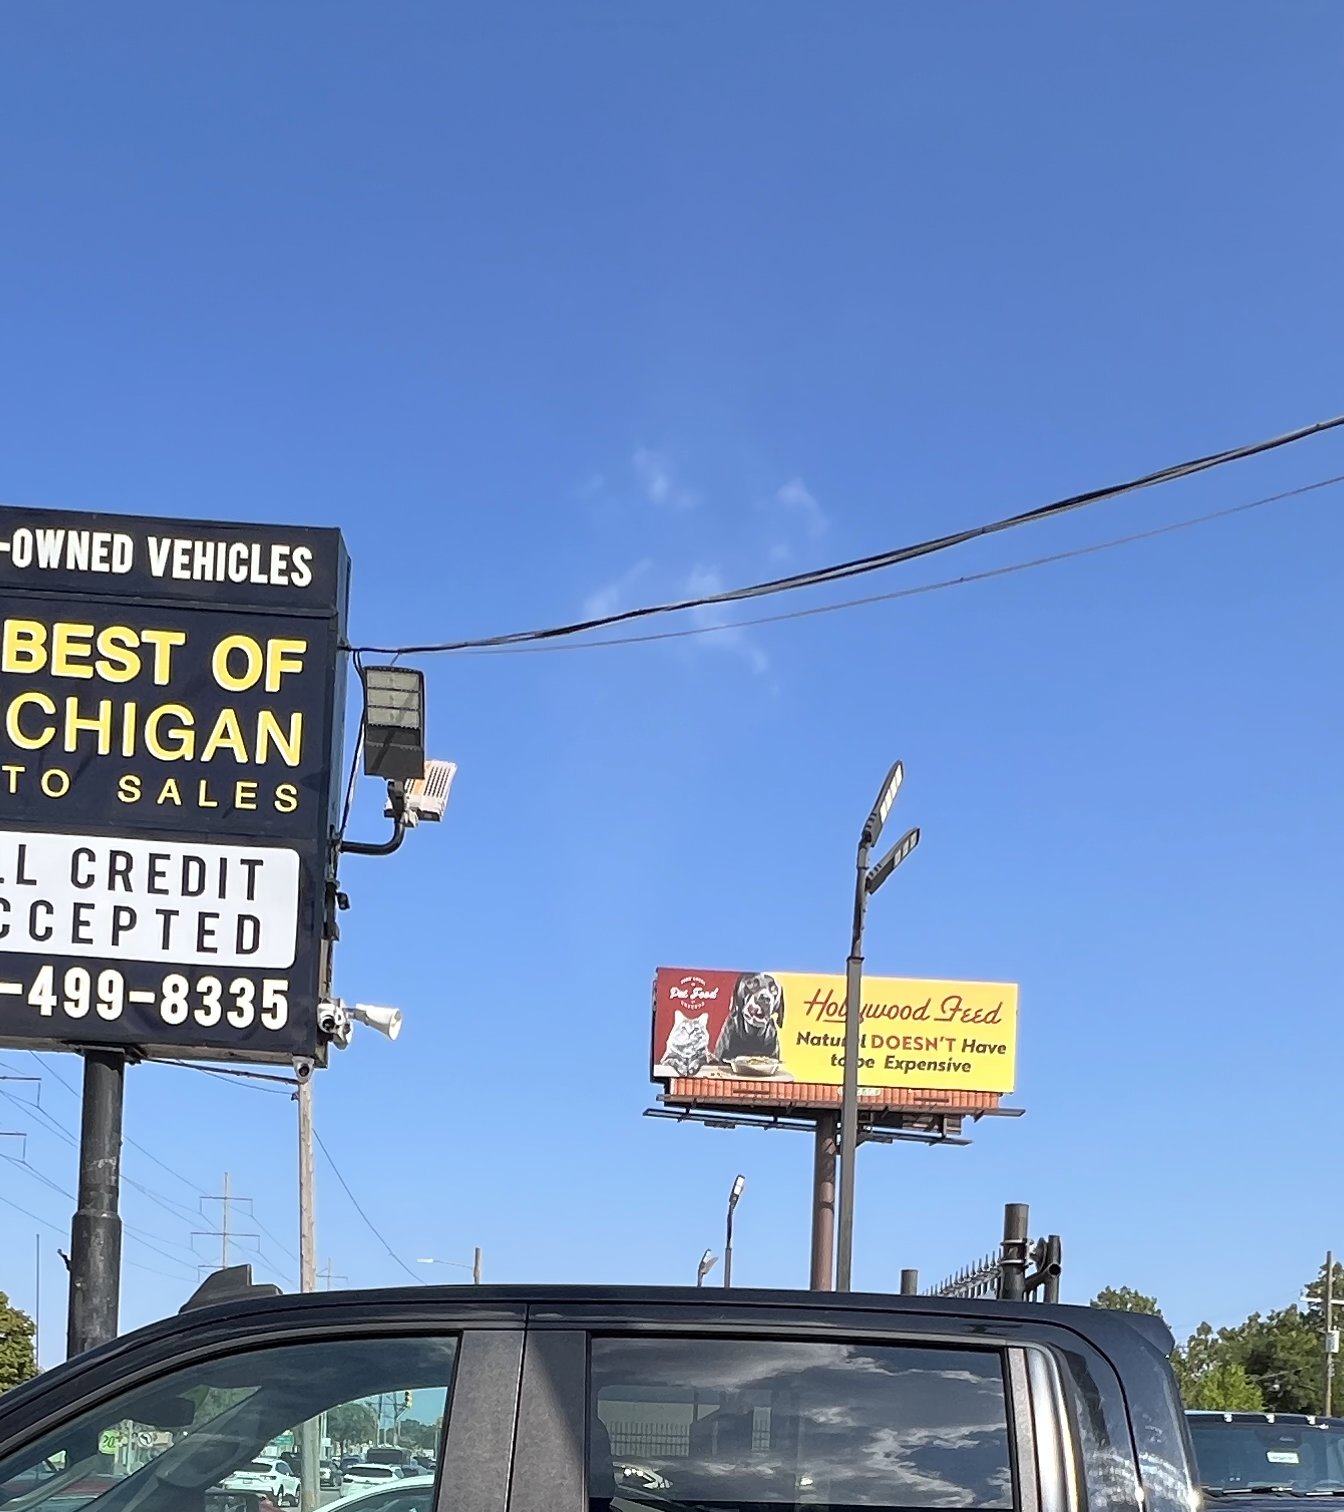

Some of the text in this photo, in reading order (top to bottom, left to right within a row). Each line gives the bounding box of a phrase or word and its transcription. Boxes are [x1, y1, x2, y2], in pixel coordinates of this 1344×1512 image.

[148, 536, 313, 588] VEHICLES
[1, 619, 308, 693] BEST OF
[117, 774, 300, 813] SALES
[70, 847, 264, 901] CREDIT
[803, 988, 1003, 1025] Holywood Feed
[796, 1031, 1007, 1055] Natul DOESN'T Have
[884, 1055, 972, 1074] Expensive
